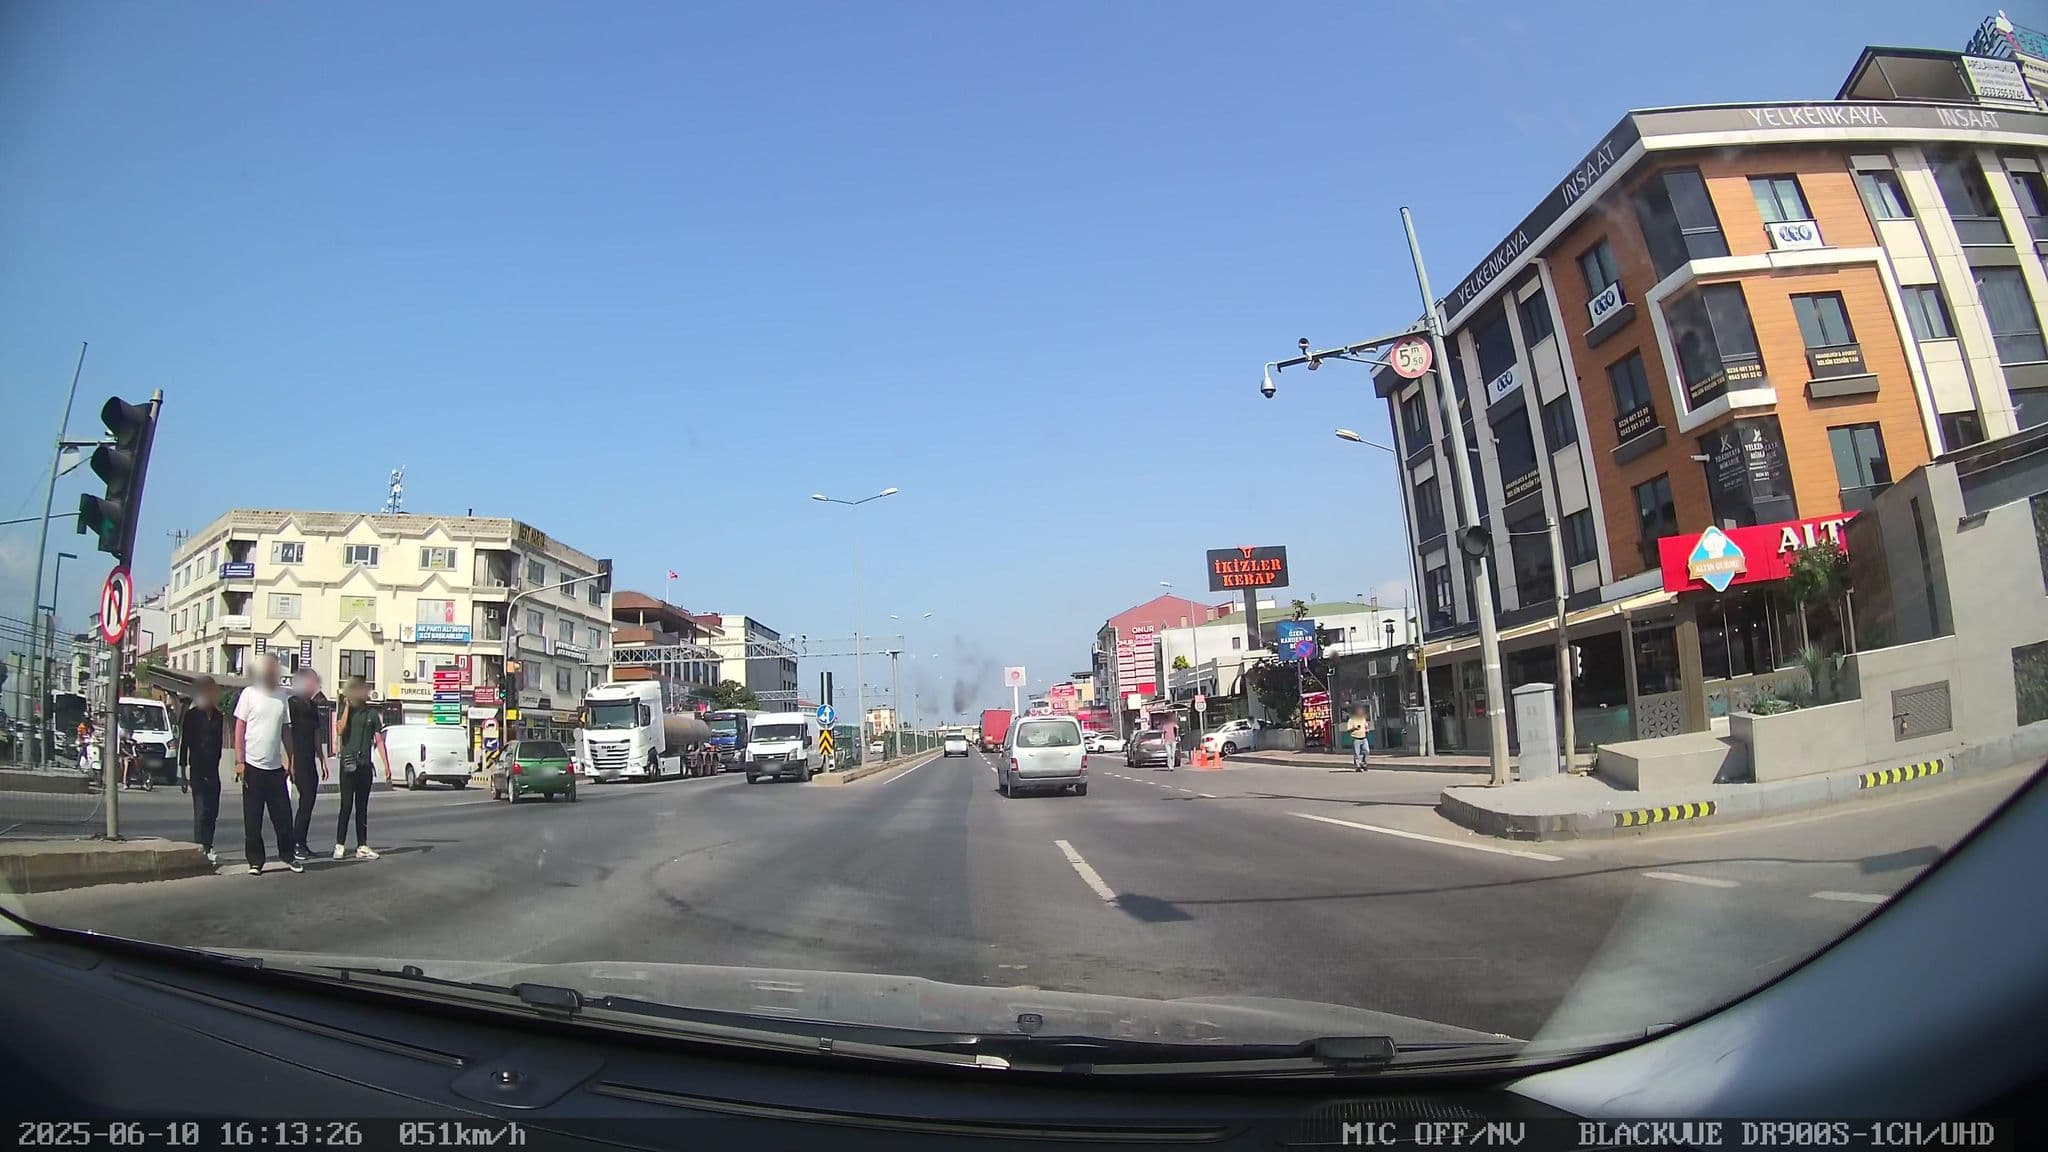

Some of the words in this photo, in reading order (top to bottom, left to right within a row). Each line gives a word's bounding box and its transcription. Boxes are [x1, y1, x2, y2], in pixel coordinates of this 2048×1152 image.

[1749, 106, 1888, 127] YELKENKAYA
[1457, 230, 1529, 305] YELKENKAYA
[1399, 348, 1411, 367] 5
[1214, 558, 1282, 574] İKİZLER
[1222, 572, 1276, 587] KEBAP
[1131, 625, 1154, 633] ONUR
[400, 688, 432, 696] TURKCELL
